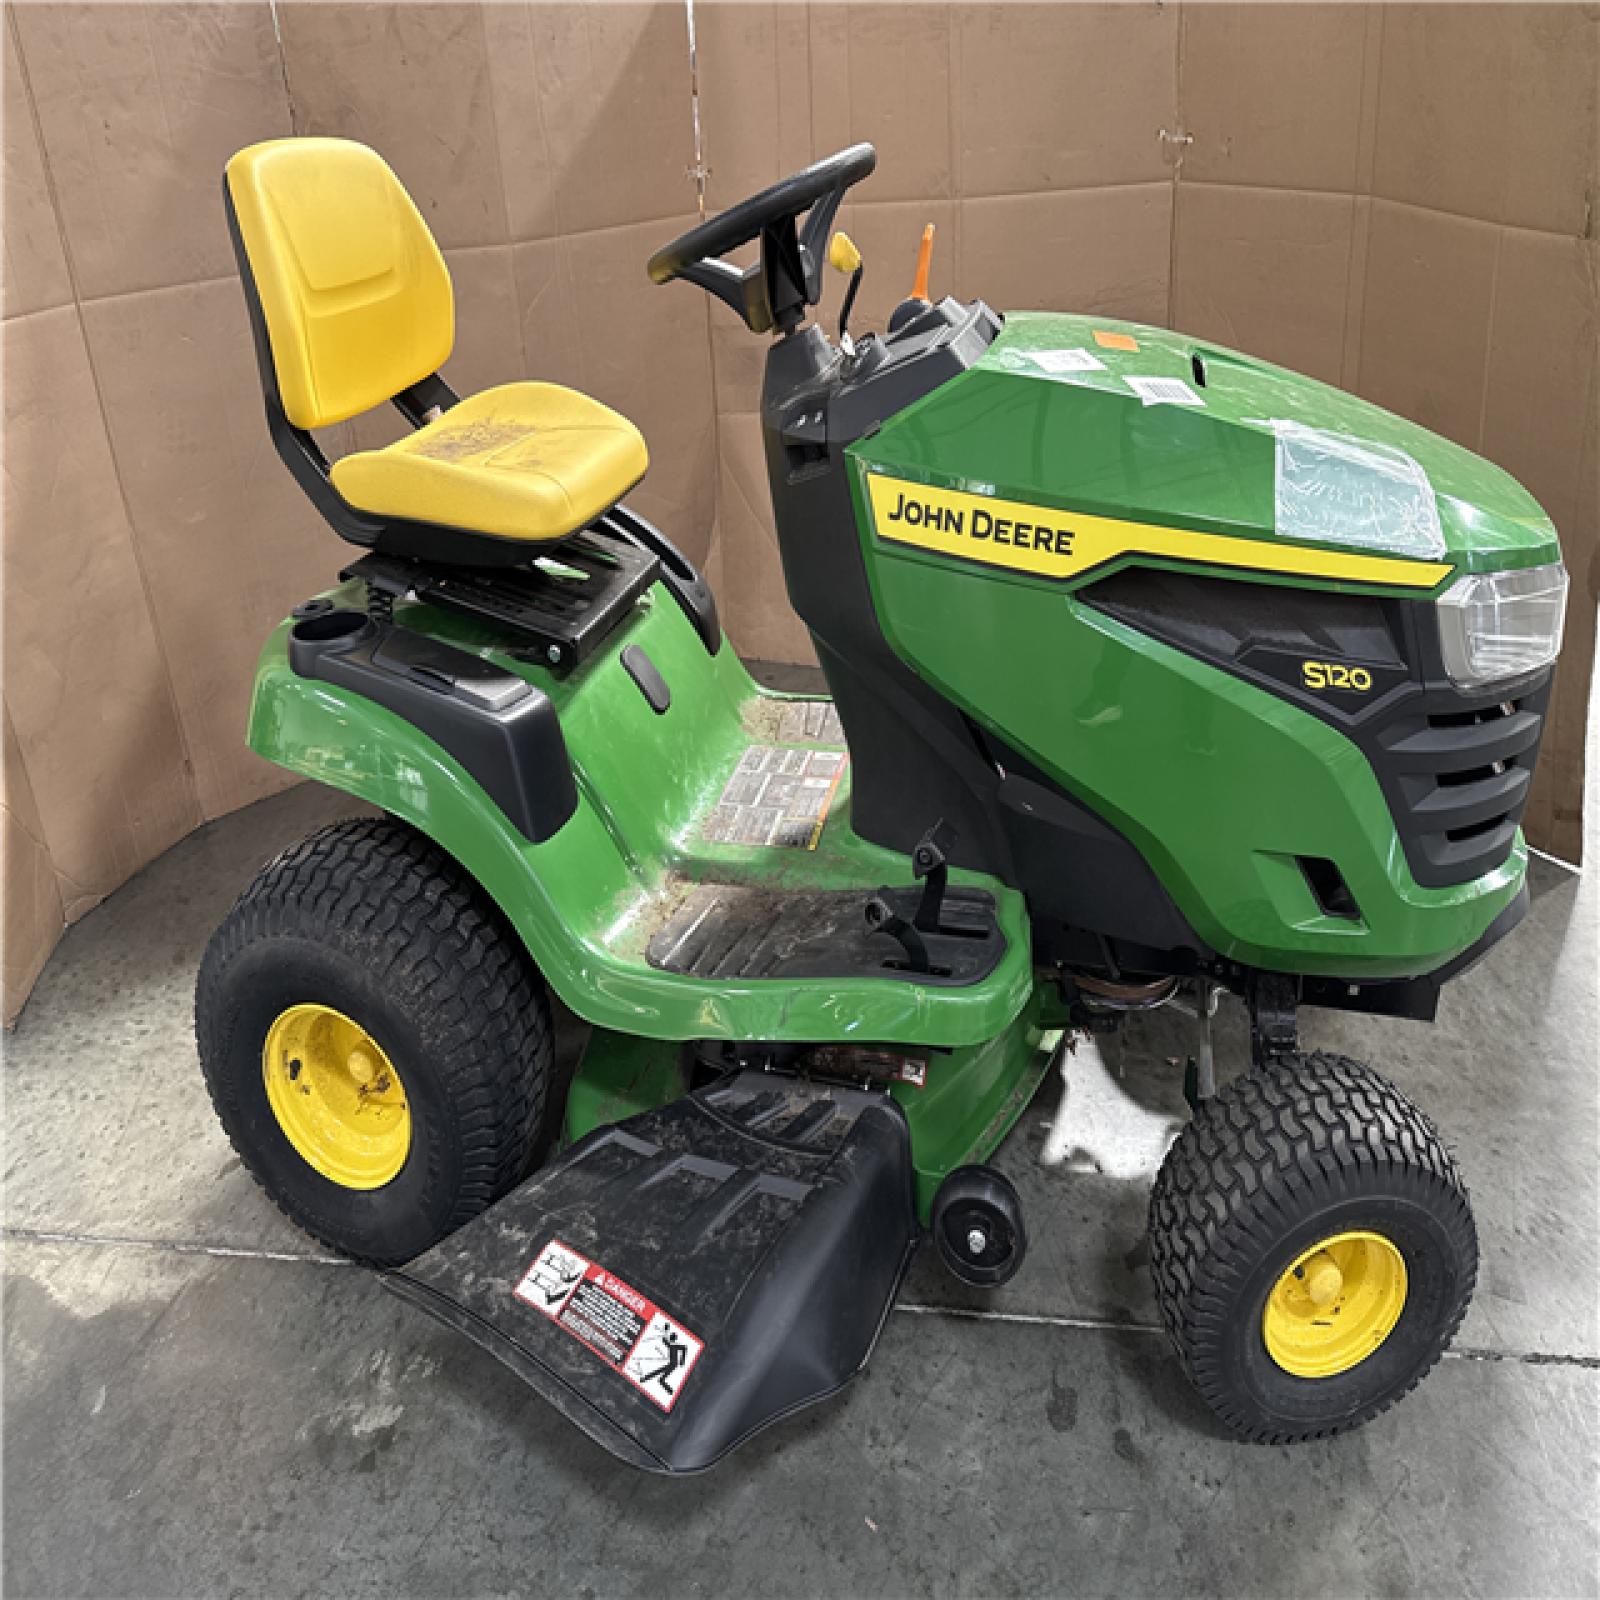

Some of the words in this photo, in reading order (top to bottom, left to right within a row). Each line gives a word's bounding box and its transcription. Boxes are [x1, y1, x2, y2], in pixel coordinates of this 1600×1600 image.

[888, 493, 964, 535] JOHN
[970, 509, 1075, 556] DEERE
[1302, 661, 1372, 691] S120
